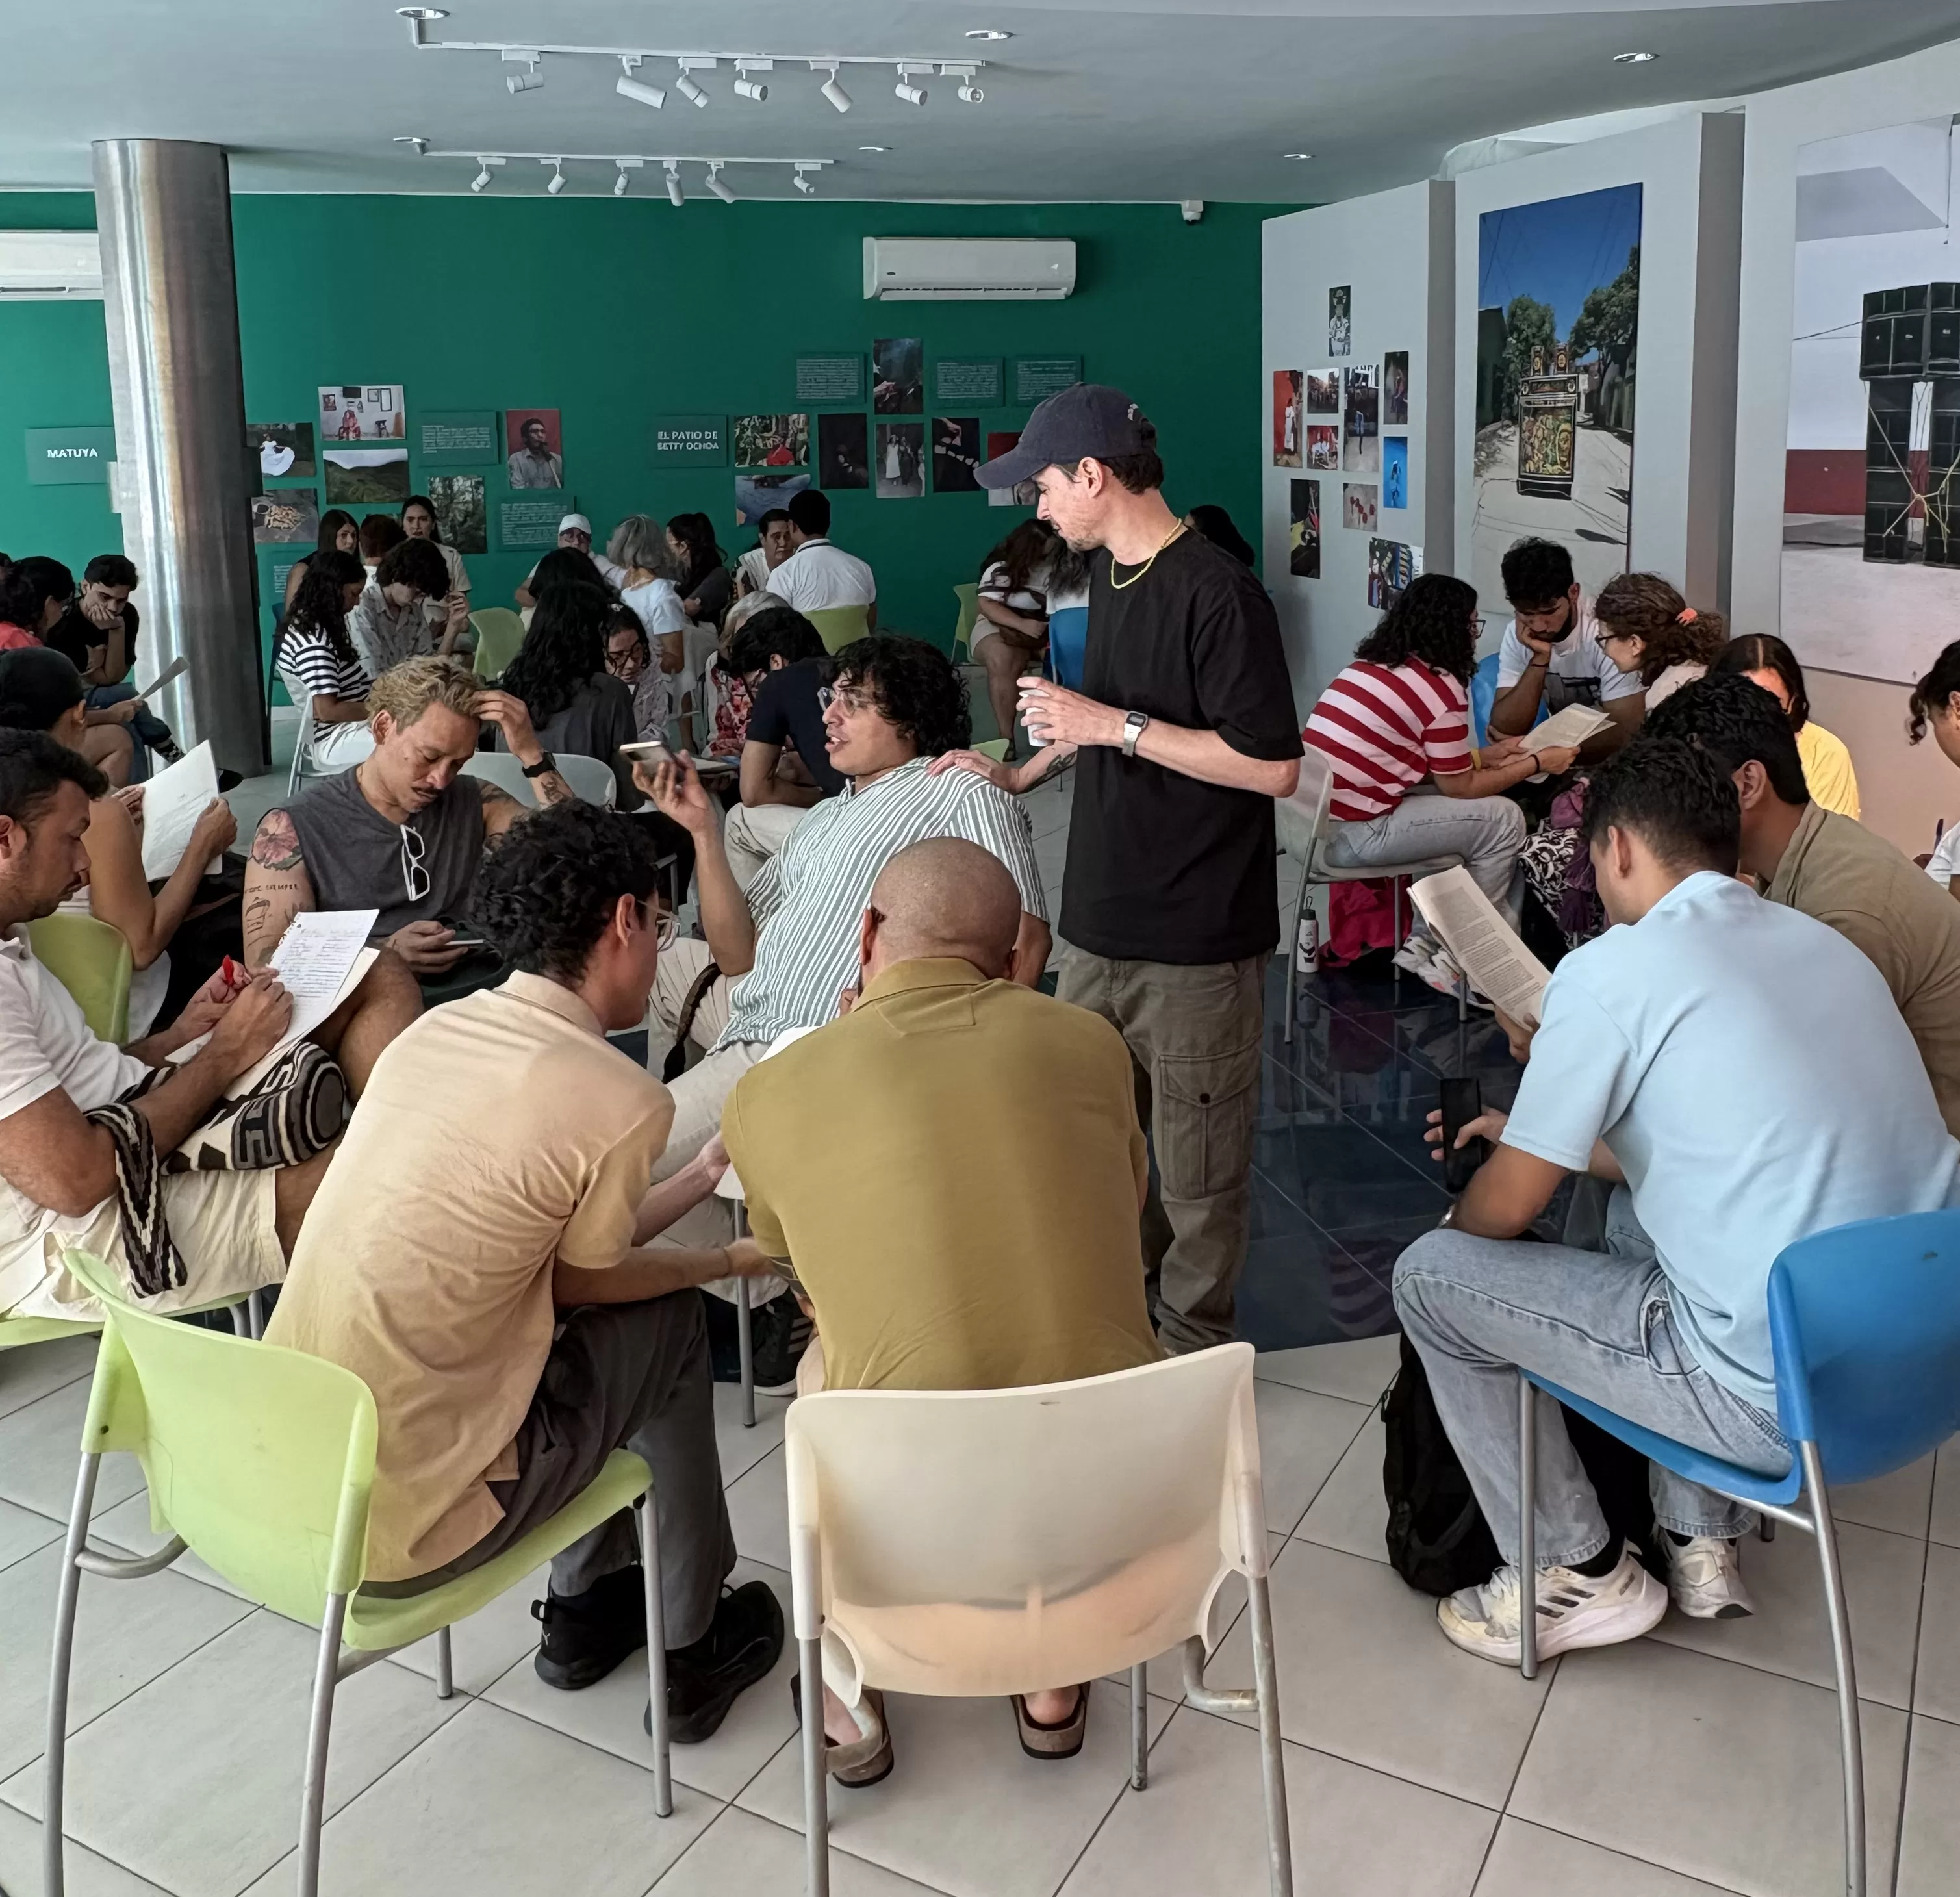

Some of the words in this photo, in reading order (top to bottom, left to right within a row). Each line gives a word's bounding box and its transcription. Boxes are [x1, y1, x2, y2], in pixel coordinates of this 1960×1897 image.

[657, 431, 670, 440] EL
[672, 431, 702, 440] PATIO
[704, 431, 718, 440] DE
[657, 442, 684, 450] BETTY
[686, 442, 719, 450] OCHOA
[47, 448, 98, 458] MATUYA
